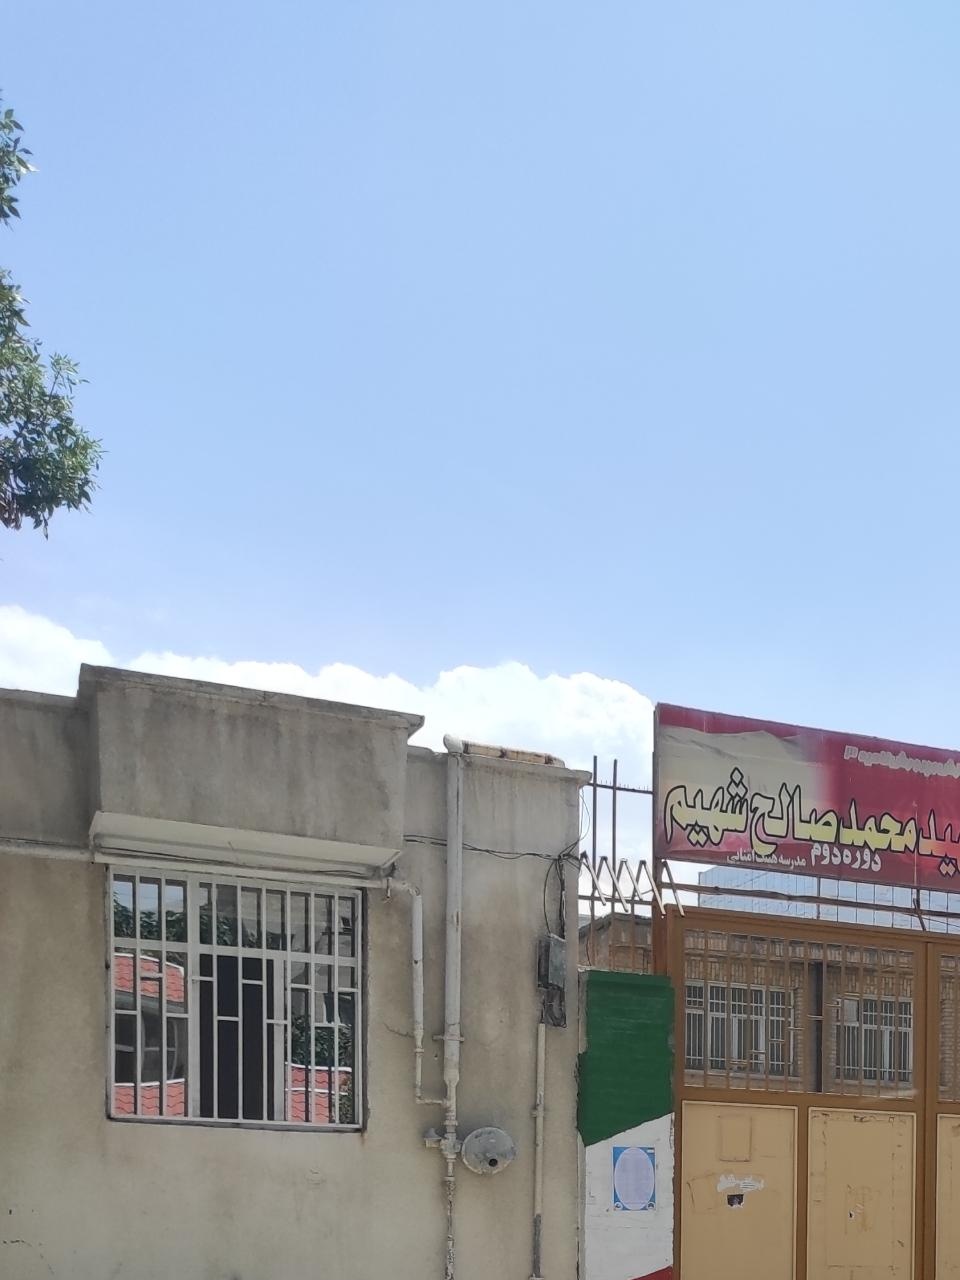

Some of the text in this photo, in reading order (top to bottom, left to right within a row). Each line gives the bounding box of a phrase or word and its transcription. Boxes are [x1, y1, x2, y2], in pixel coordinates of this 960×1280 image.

[664, 766, 748, 847] شهیم
[750, 782, 838, 856] صالح
[839, 798, 917, 853] محمد
[778, 854, 807, 869] مدرسه
[811, 843, 882, 872] دوره دوم
